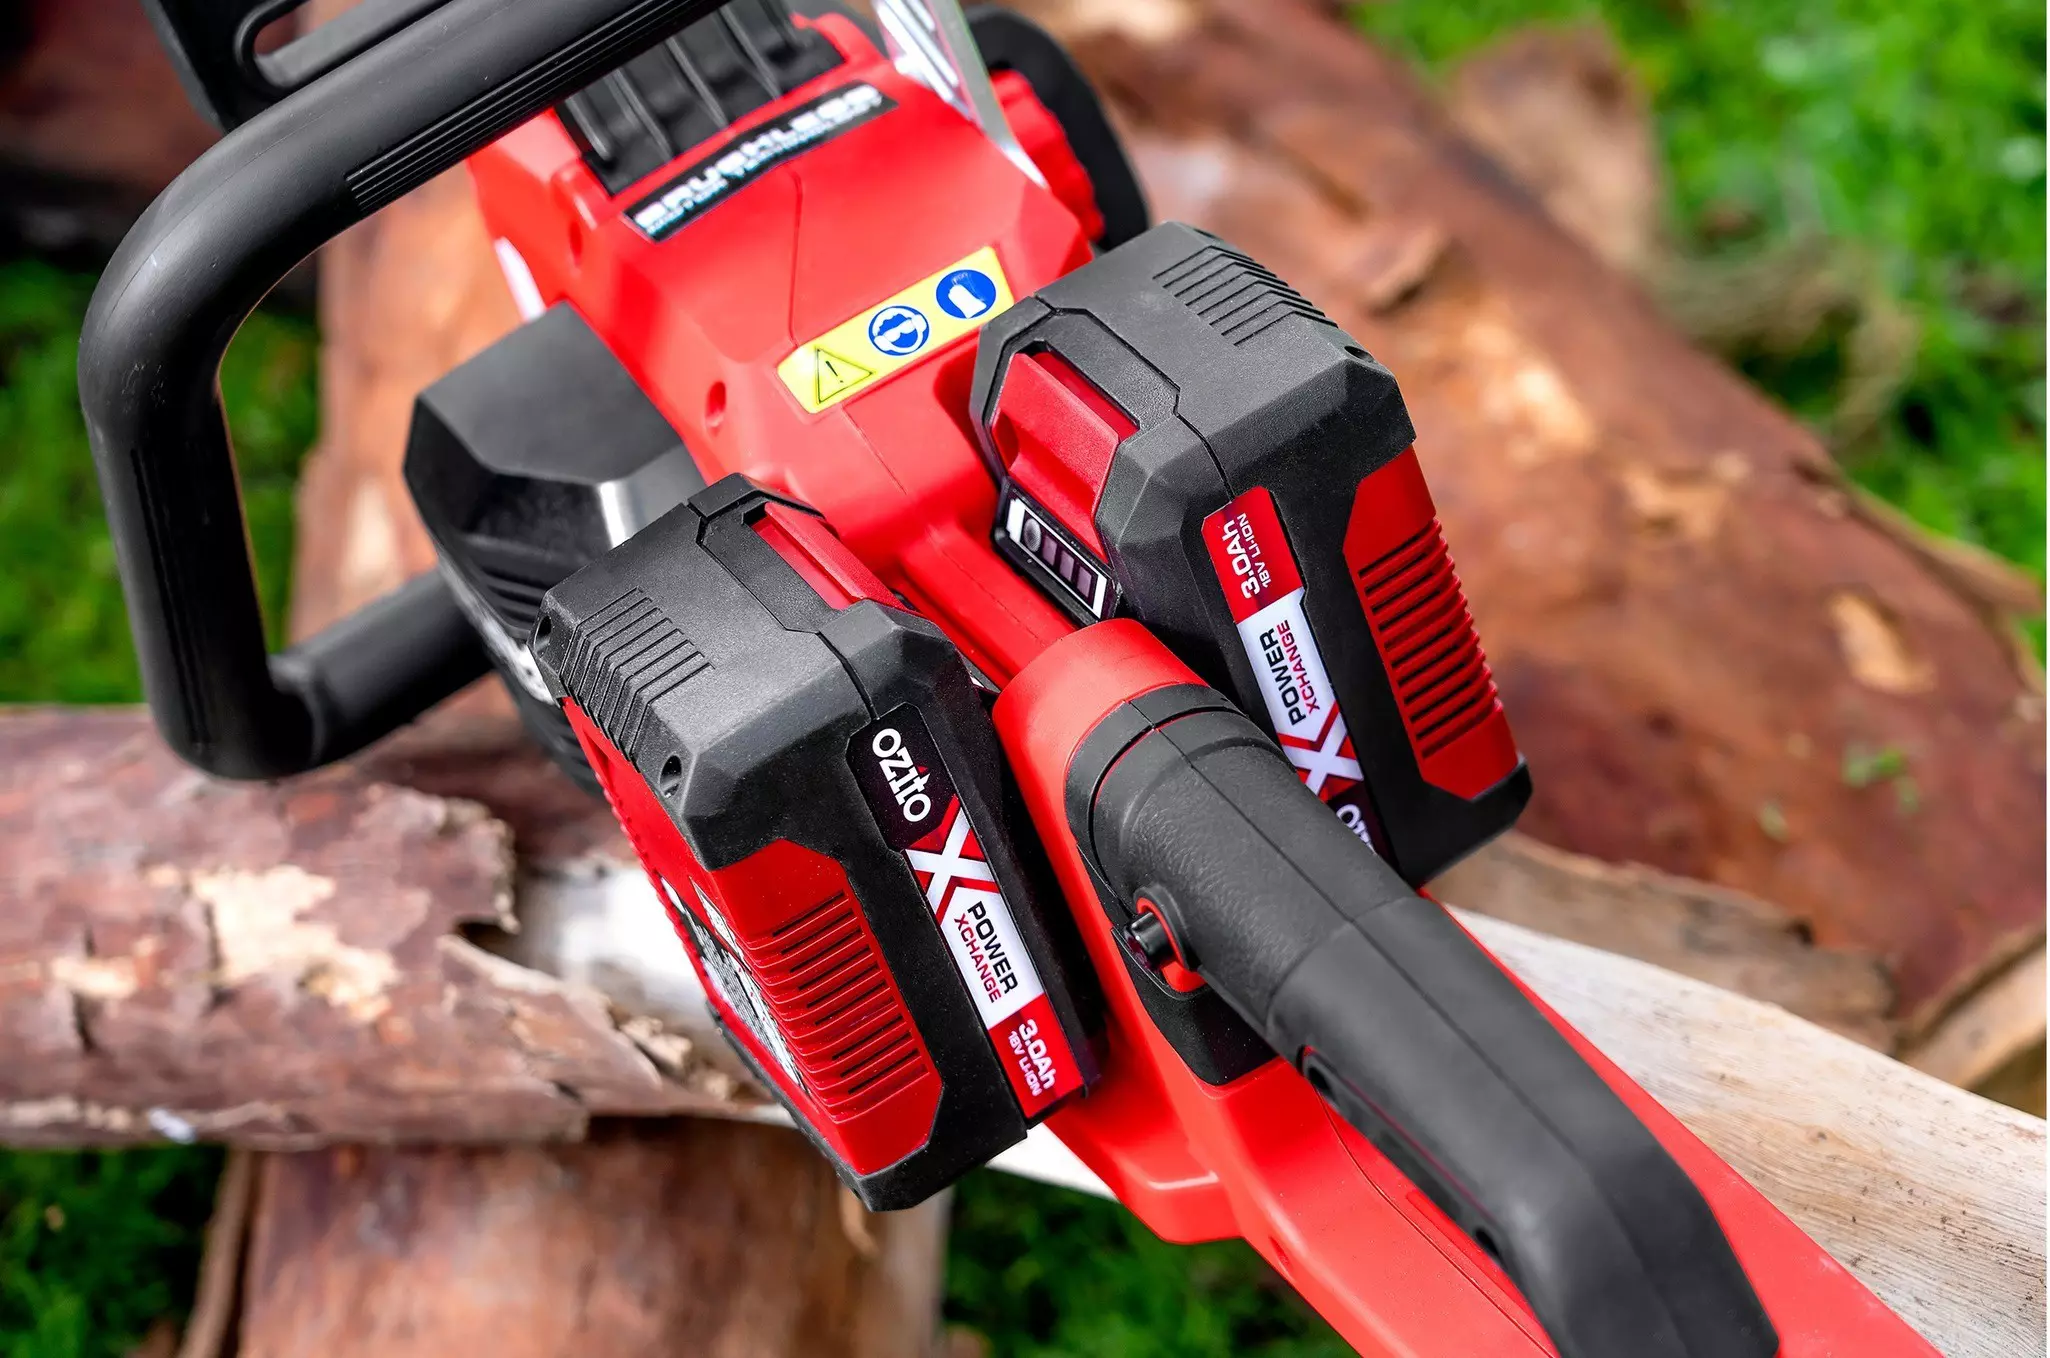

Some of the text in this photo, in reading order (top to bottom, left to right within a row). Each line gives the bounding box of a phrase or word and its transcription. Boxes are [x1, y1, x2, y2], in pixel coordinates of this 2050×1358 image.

[633, 84, 880, 229] BRUSHLESS
[1221, 519, 1260, 599] 3.0Ah
[1254, 561, 1271, 588] 18V
[1259, 627, 1306, 726] POWER
[1276, 619, 1320, 714] XCHANGE
[872, 728, 931, 822] ozito
[953, 913, 1002, 1004] XCHANGE
[967, 900, 1018, 994] POWER
[1007, 1030, 1025, 1057] 18V
[1018, 1018, 1056, 1090] 3.0Ah
